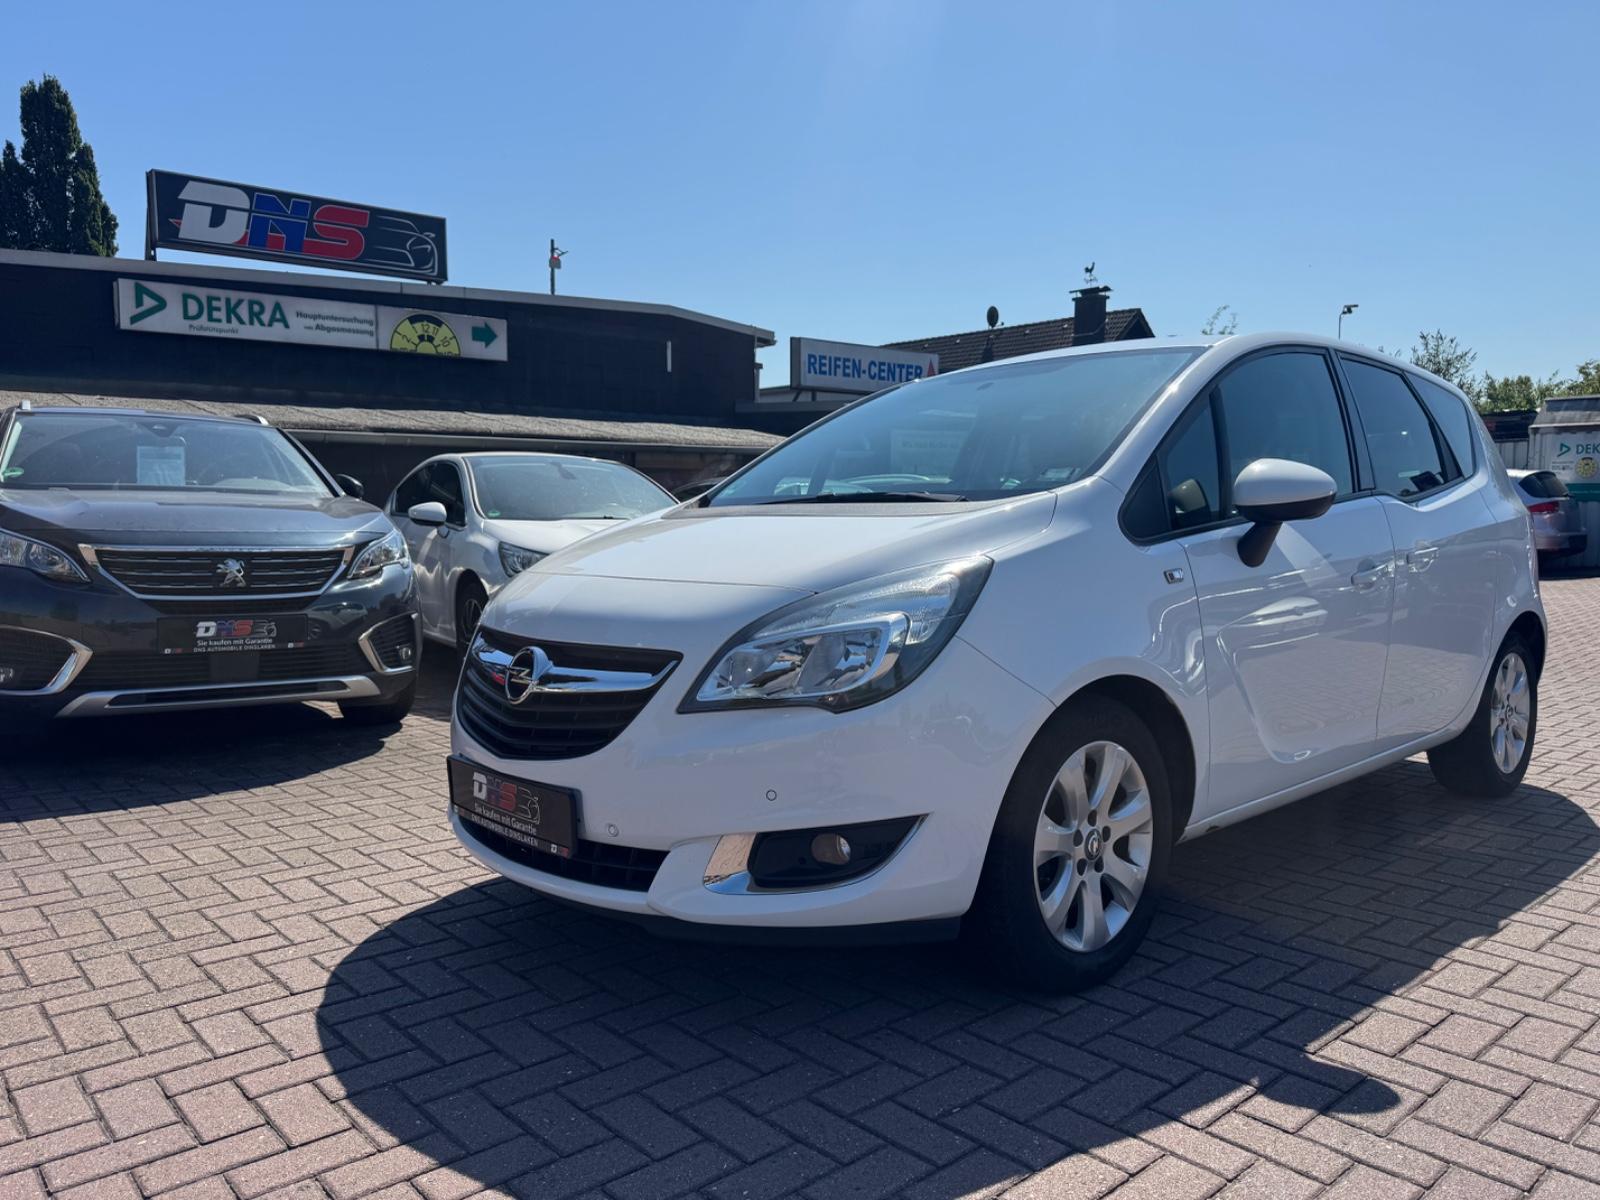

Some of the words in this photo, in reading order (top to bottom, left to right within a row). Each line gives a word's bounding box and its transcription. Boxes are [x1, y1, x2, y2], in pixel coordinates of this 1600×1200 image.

[177, 180, 370, 261] DNS
[181, 292, 290, 329] DEKRA
[807, 353, 923, 382] REIFEN-CENTER
[196, 639, 208, 647] Sie
[232, 638, 244, 646] mit
[501, 813, 511, 826] mit
[511, 818, 537, 836] Garantie
